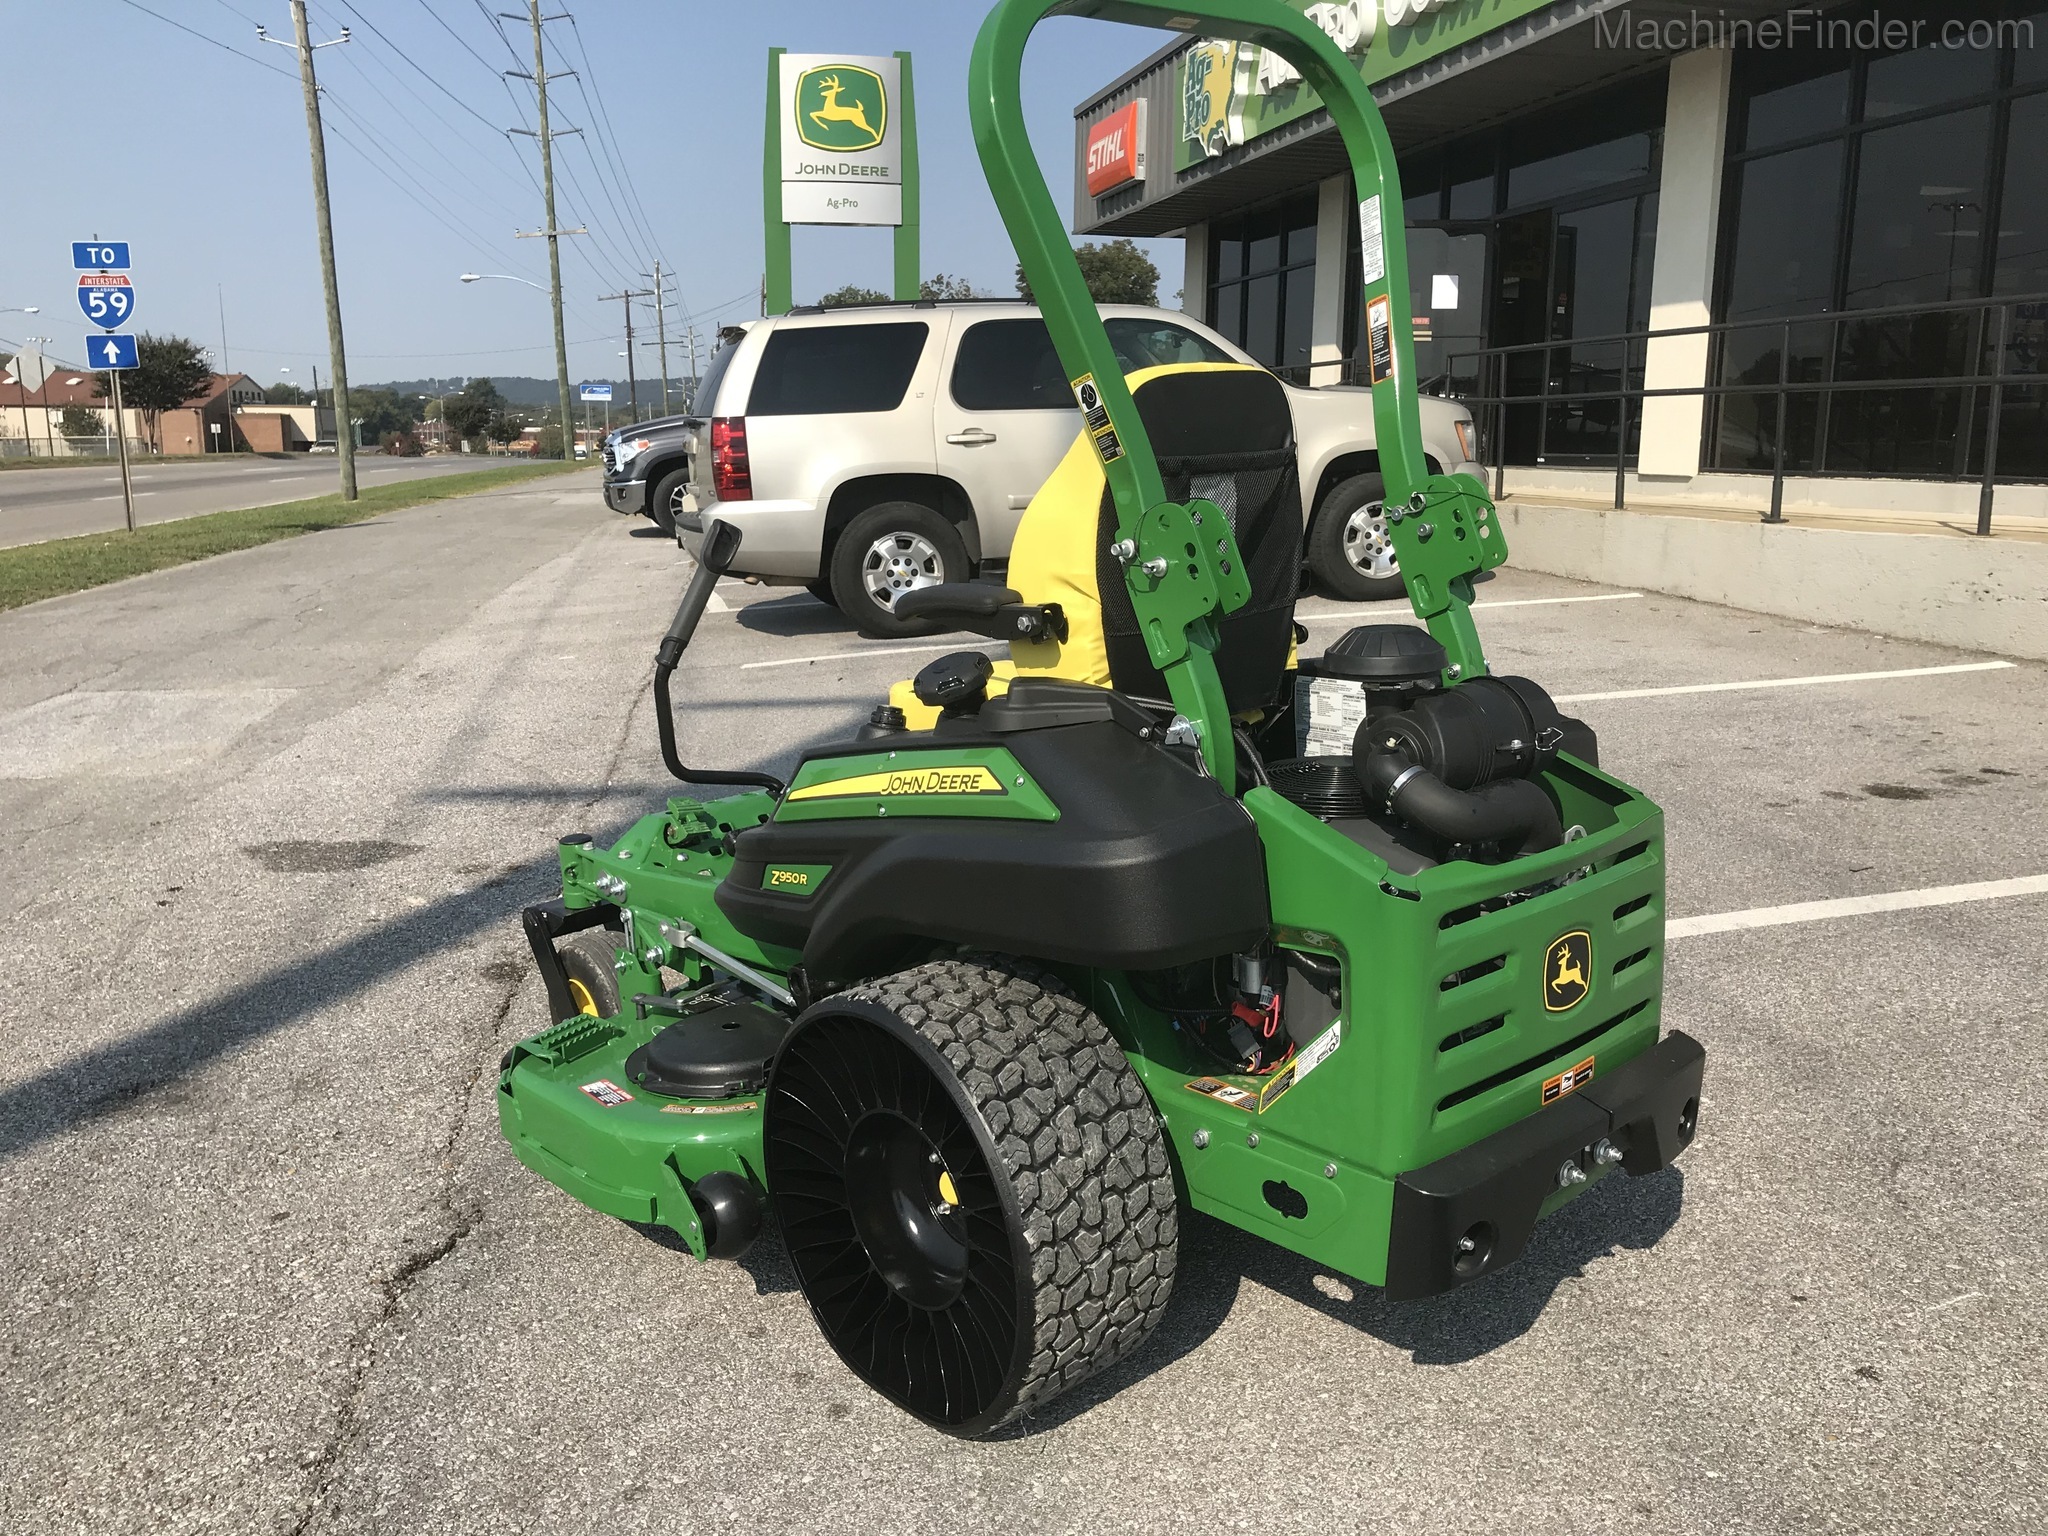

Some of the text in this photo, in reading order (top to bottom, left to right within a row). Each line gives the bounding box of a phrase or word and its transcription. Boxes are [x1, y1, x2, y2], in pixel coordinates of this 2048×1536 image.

[1185, 50, 1213, 98] Ag-
[1185, 91, 1211, 137] Pro
[1088, 127, 1125, 175] STIHL
[795, 162, 889, 177] JOHN DEERE
[827, 197, 858, 209] Ag-Pro
[87, 247, 115, 264] TO
[84, 277, 125, 286] INTERSTATE
[89, 292, 128, 318] 59
[881, 772, 983, 792] JOHN DEERE
[771, 870, 808, 885] Z950R
